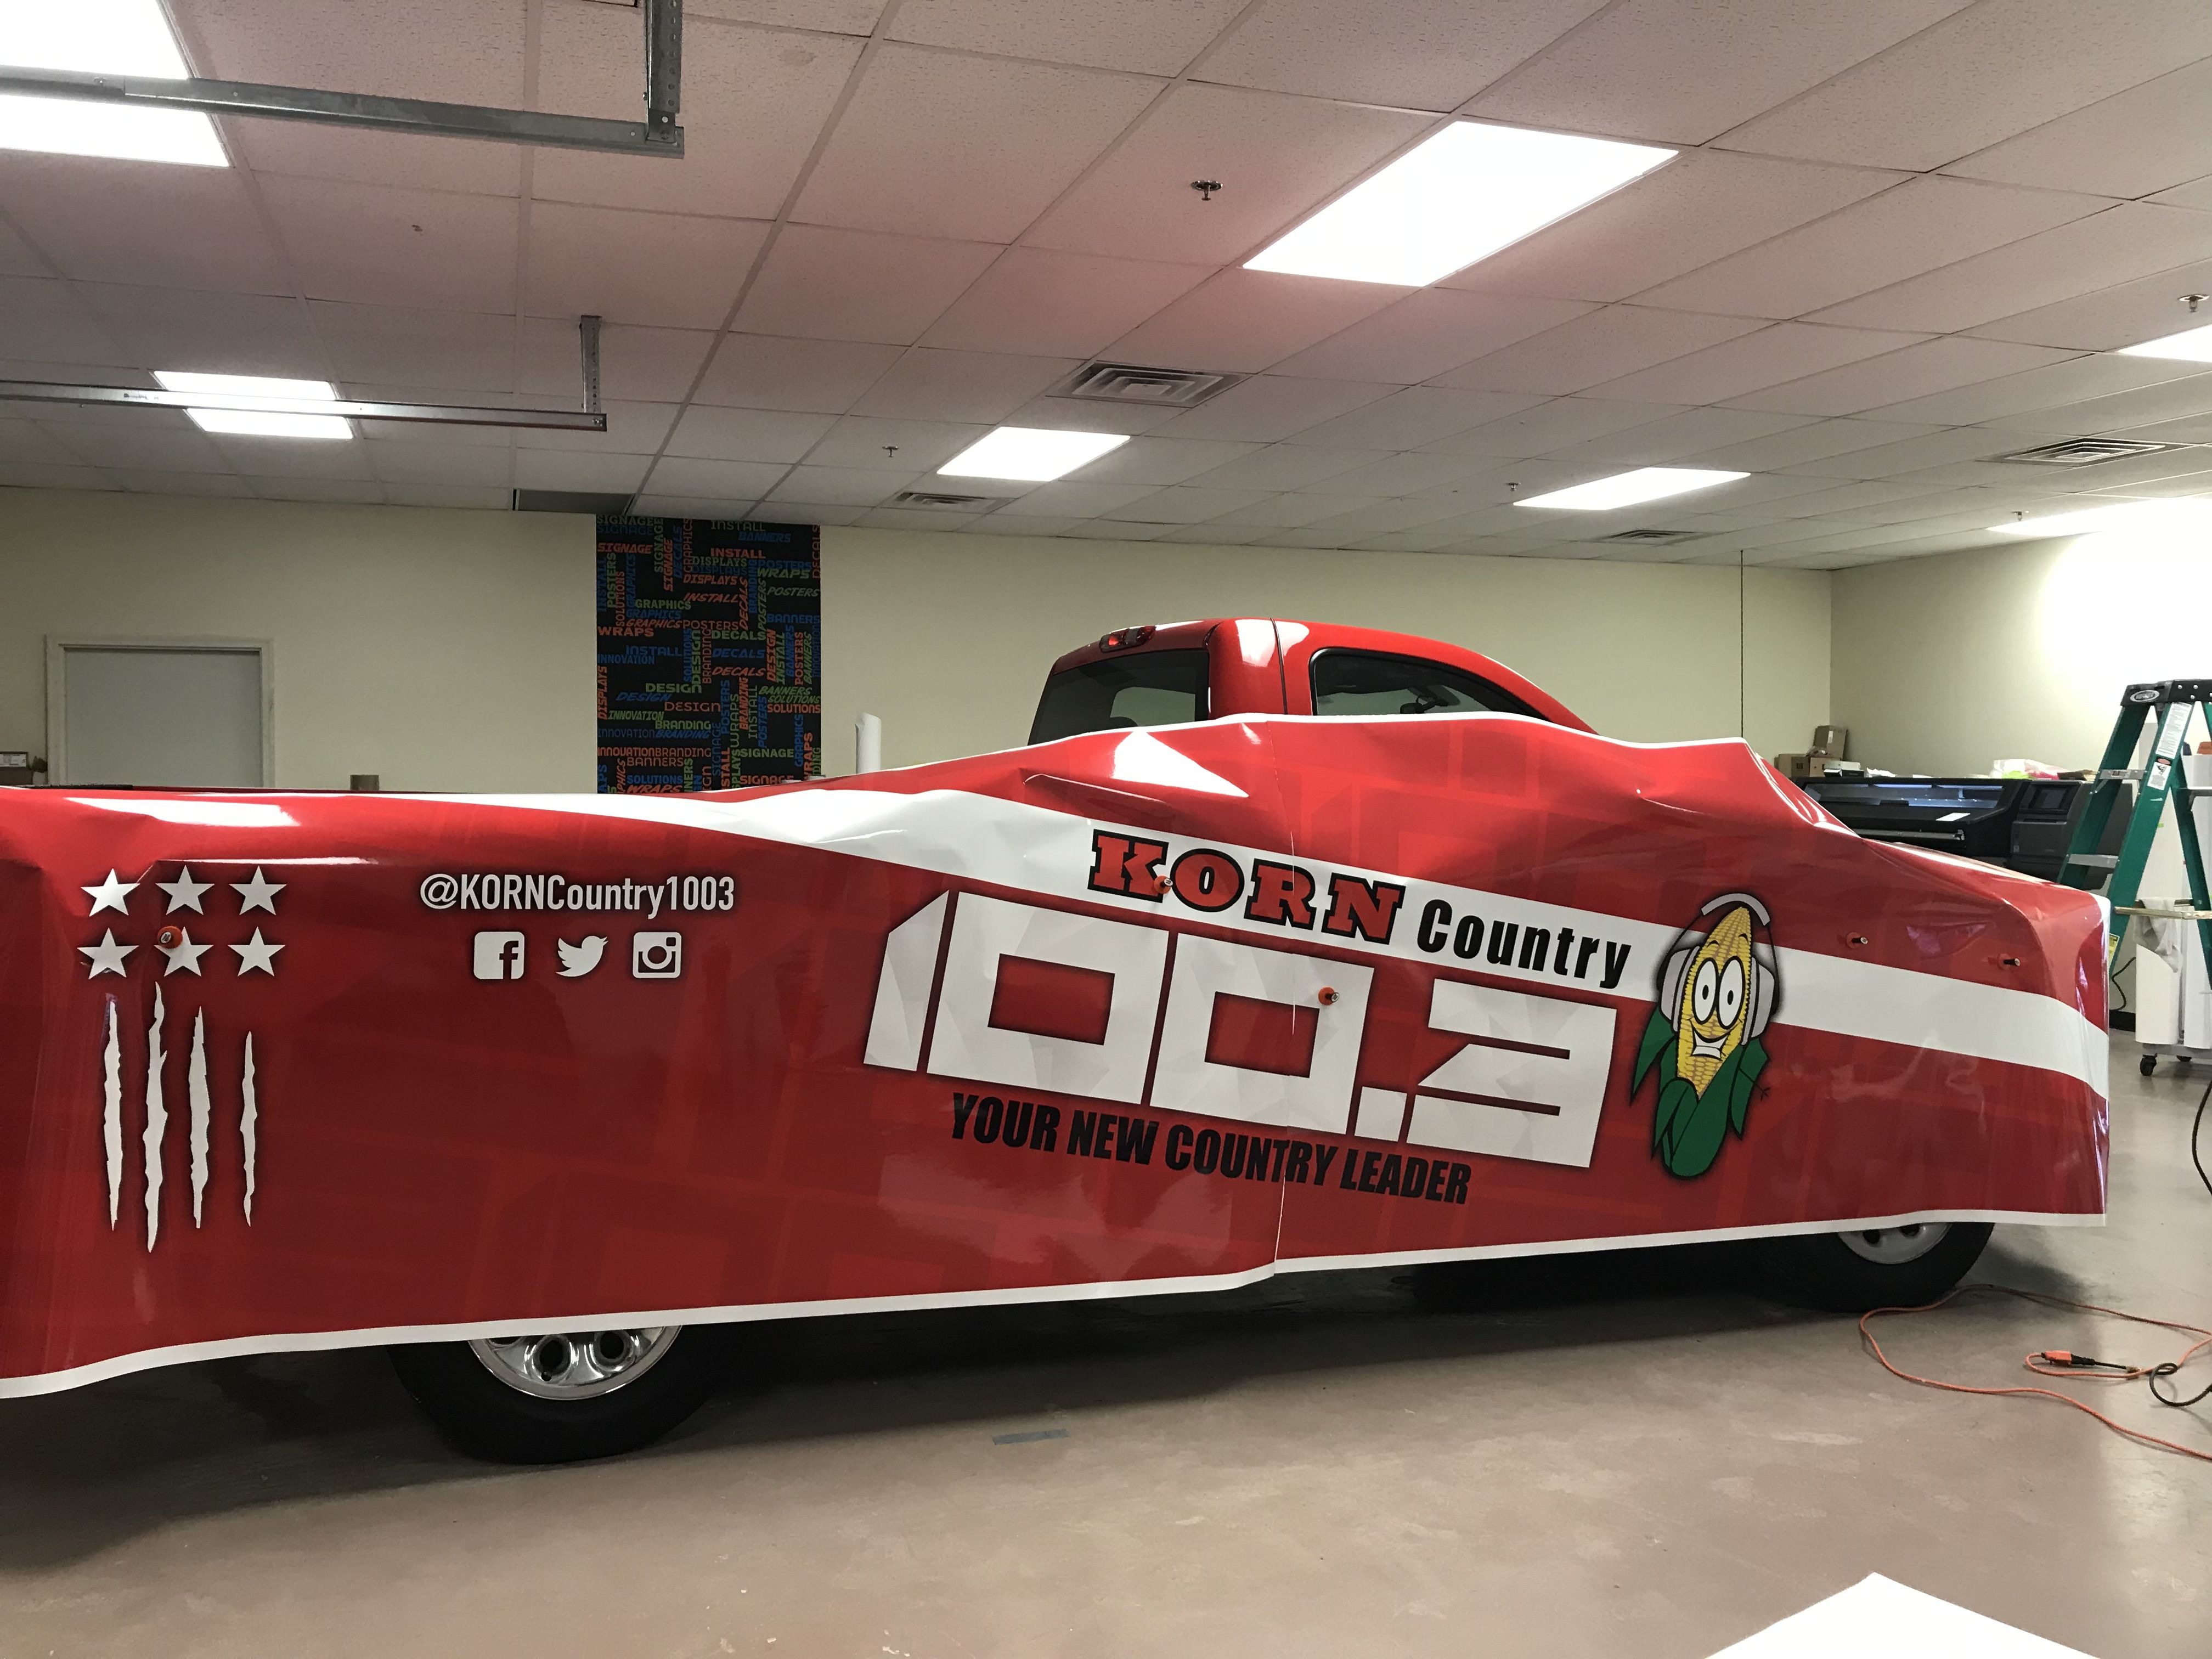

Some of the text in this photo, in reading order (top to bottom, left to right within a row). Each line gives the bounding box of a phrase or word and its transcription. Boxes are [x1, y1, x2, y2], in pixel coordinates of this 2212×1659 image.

[597, 516, 654, 526] SIGNAGE
[738, 531, 792, 543] BANNERS
[597, 542, 653, 554] SIGNAGE
[654, 517, 663, 573] SIGNAGE
[673, 525, 682, 579] DECALS
[711, 548, 766, 558] INSTALL
[663, 538, 674, 591] SIGNAGE
[692, 556, 747, 567] DISPLAYS
[758, 560, 811, 571] POSTERS
[758, 568, 811, 579] WRAPS
[607, 552, 616, 608] POSTERS
[683, 574, 738, 585] DISPLAYS
[748, 560, 757, 613] BRANDING
[767, 586, 820, 597] POSTERS
[616, 571, 625, 627] SOLUTIONS
[683, 592, 739, 602] INSTALL
[636, 599, 691, 610] GRAPHICS
[739, 576, 749, 631] DECALS
[758, 578, 767, 631] POSTERS
[626, 608, 682, 619] GRAPHICS
[767, 613, 820, 623] BANNERS
[626, 618, 682, 629] GRAPHICS
[683, 619, 739, 630] POSTERS
[597, 626, 654, 637] WRAPS
[711, 630, 766, 641] DECALS
[625, 645, 682, 656] INSTALL
[683, 628, 692, 682] SOLUTIONS
[712, 648, 765, 658] DECALS
[766, 628, 776, 682] DESIGN
[785, 625, 794, 677] BANNERS
[597, 654, 655, 664] INNOVATION
[692, 630, 701, 684] DESIGN
[702, 629, 712, 684] BRANDING
[776, 632, 785, 685] INSTALL
[794, 632, 804, 685] POSTERS
[804, 631, 812, 685] BANNERS
[712, 666, 766, 676] DECALS
[597, 665, 608, 720] DISPLAYS
[646, 683, 702, 693] DESIGN
[759, 686, 812, 695] BANNERS
[616, 692, 672, 702] DESIGN
[768, 695, 821, 704] SOLUTIONS
[664, 702, 721, 712] DESIGN
[721, 680, 730, 734] POSTERS
[739, 676, 748, 731] BRANDING
[767, 703, 821, 713] SOLUTIONS
[608, 710, 664, 720] INNOVATION
[748, 685, 757, 739] INSTALL
[655, 720, 711, 730] BRANDING
[730, 693, 739, 748] WRAPS
[758, 696, 768, 748] POSTERS
[655, 729, 711, 739] BRANDING
[794, 714, 804, 767] GRAPHICS
[597, 747, 655, 757] INNOVATION
[655, 747, 711, 757] BRANDING
[740, 748, 794, 757] SIGNAGE
[627, 757, 684, 766] BANNERS
[721, 747, 730, 789] STALL
[597, 764, 607, 793] APS
[616, 758, 626, 793] PHICS
[627, 775, 683, 785] SOLUTIONS
[684, 758, 693, 792] NERS
[627, 785, 683, 793] WRAPS
[420, 873, 734, 919] @KORNCountry1003
[1087, 829, 1632, 989] KORN Country
[864, 889, 1617, 1169] 100.3
[952, 1092, 1472, 1205] YOUR NEW COUNTRY LEADER
